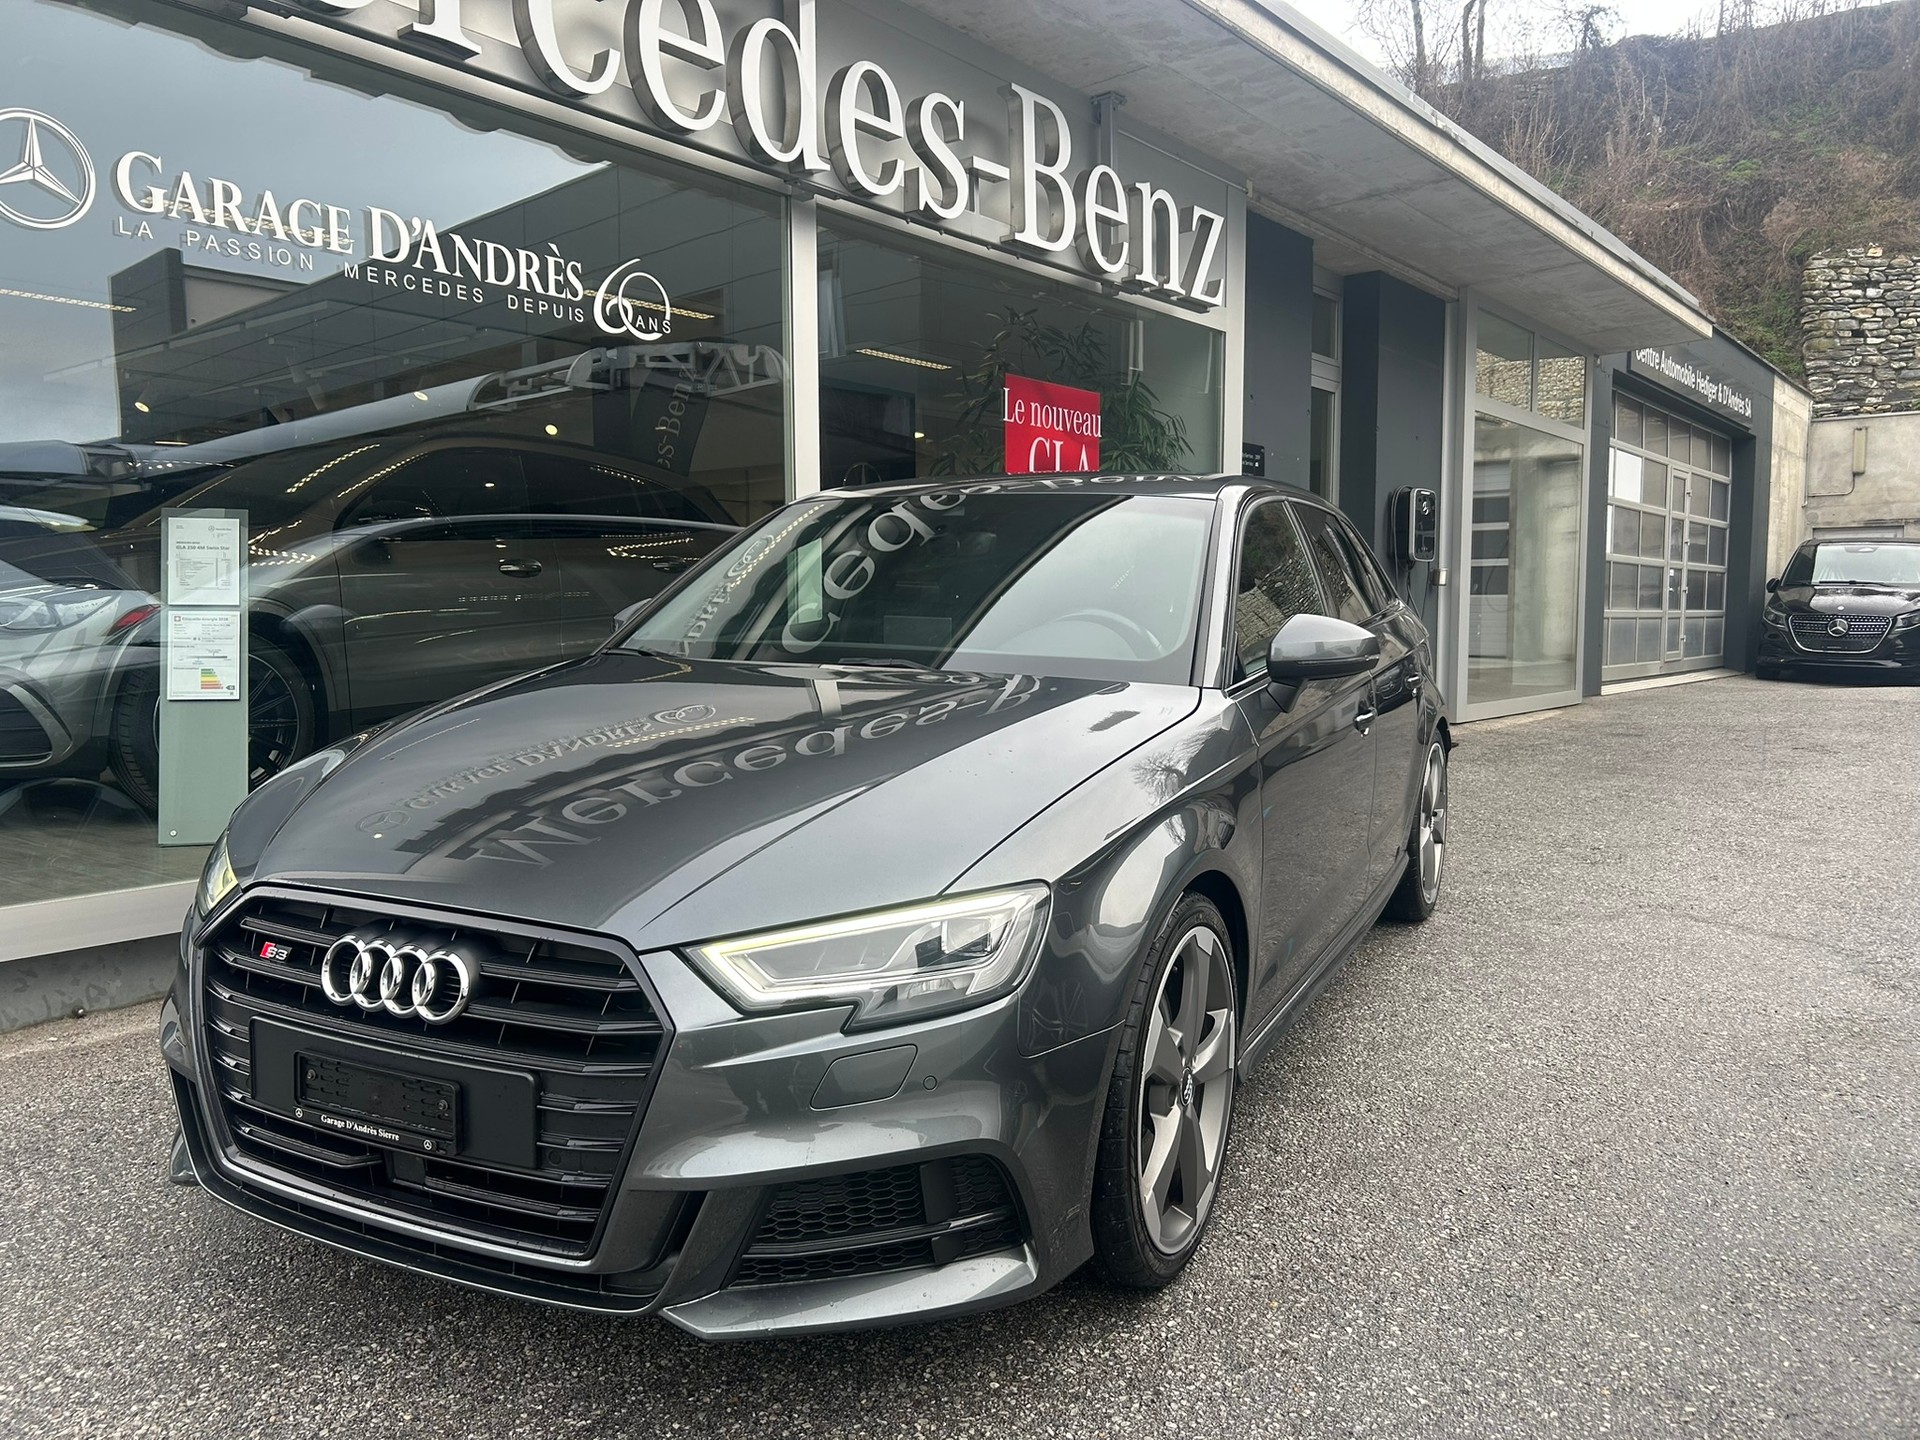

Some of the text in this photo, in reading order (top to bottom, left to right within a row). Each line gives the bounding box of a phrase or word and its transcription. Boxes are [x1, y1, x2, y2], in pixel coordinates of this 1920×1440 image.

[285, 0, 1225, 306] cedes-Benz
[116, 150, 584, 301] GARAGE D'ANDRÈS
[119, 216, 154, 239] LA
[186, 230, 313, 271] PASSION
[344, 262, 483, 303] MERCEDES
[507, 294, 584, 323] DEPUIS
[636, 317, 672, 334] ANS
[1660, 350, 1696, 389] Automobile
[1718, 383, 1723, 403] &
[1003, 387, 1102, 438] Le nouveau
[263, 945, 288, 961] S3
[320, 1114, 400, 1141] Garage D'Andrès Sierre
